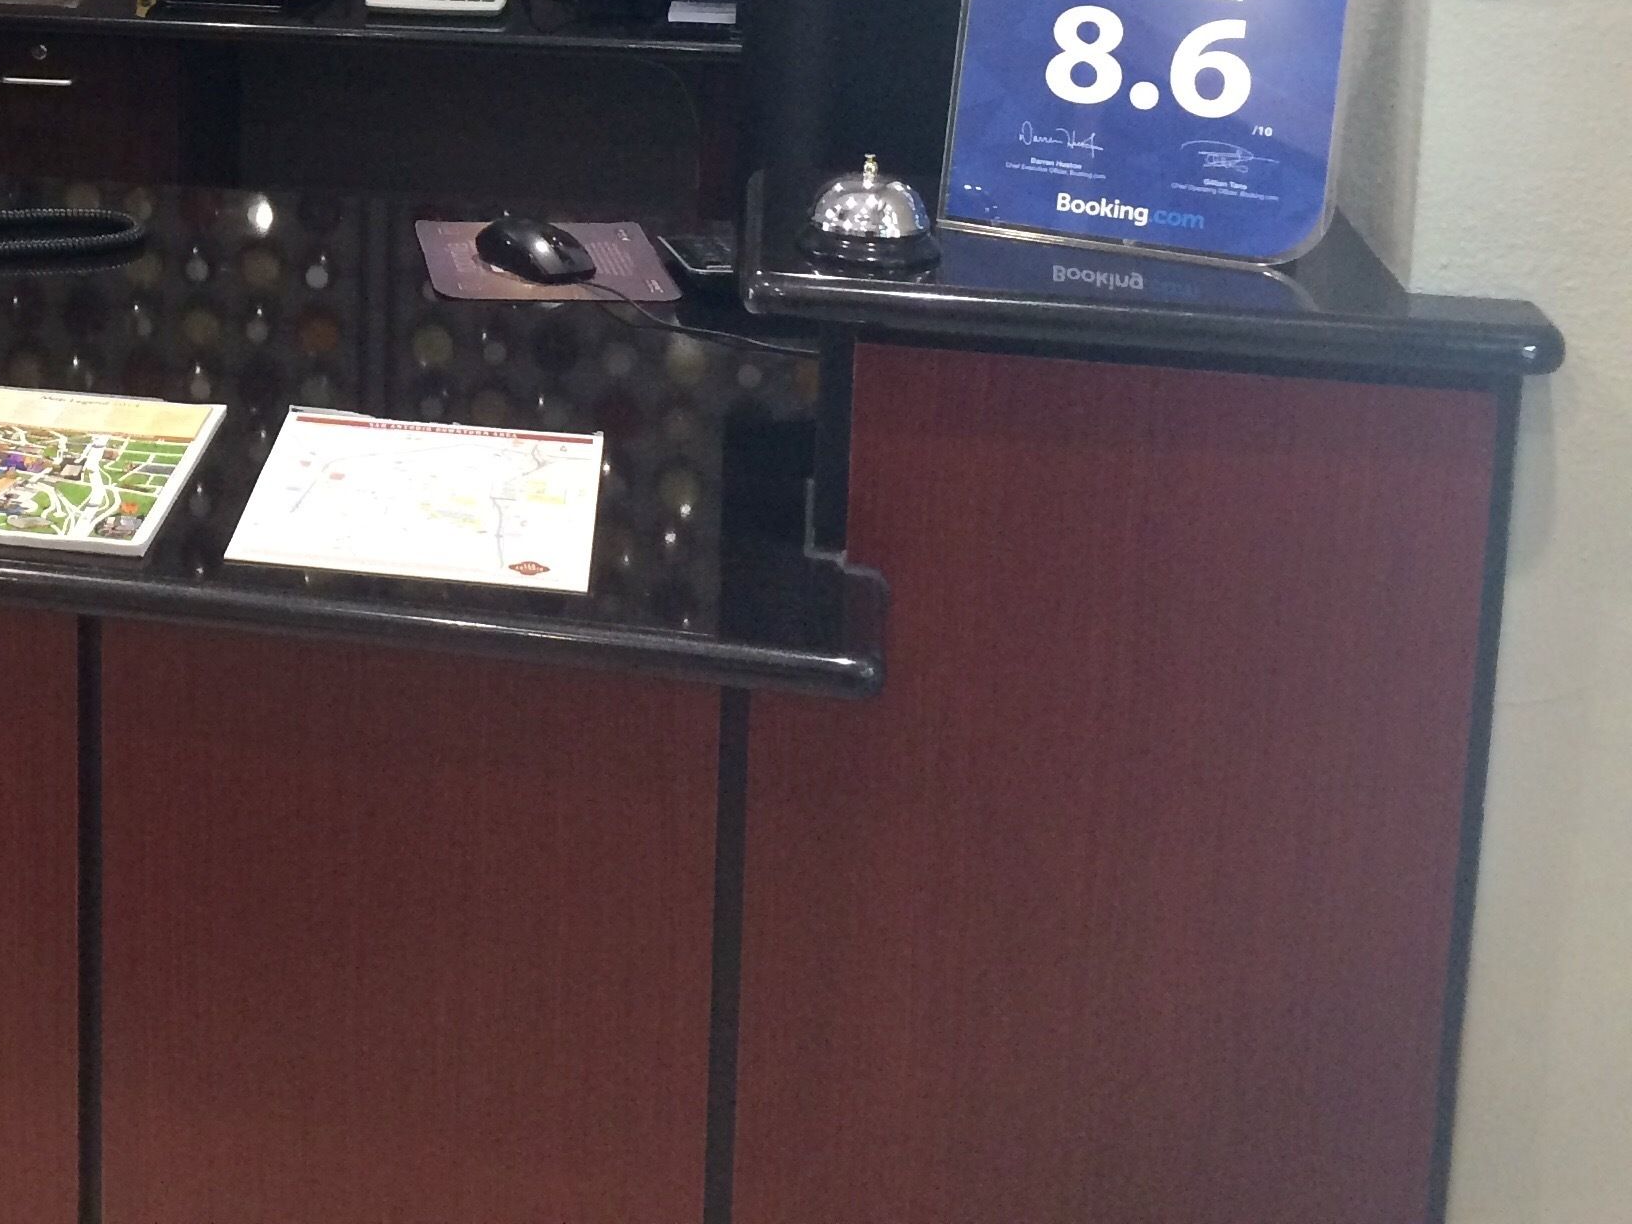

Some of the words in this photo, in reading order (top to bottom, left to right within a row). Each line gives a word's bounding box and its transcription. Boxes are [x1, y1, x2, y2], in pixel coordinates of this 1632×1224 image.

[1045, 5, 1252, 119] 8.6
[1251, 125, 1273, 137] /10
[1056, 191, 1205, 230] Booking.com
